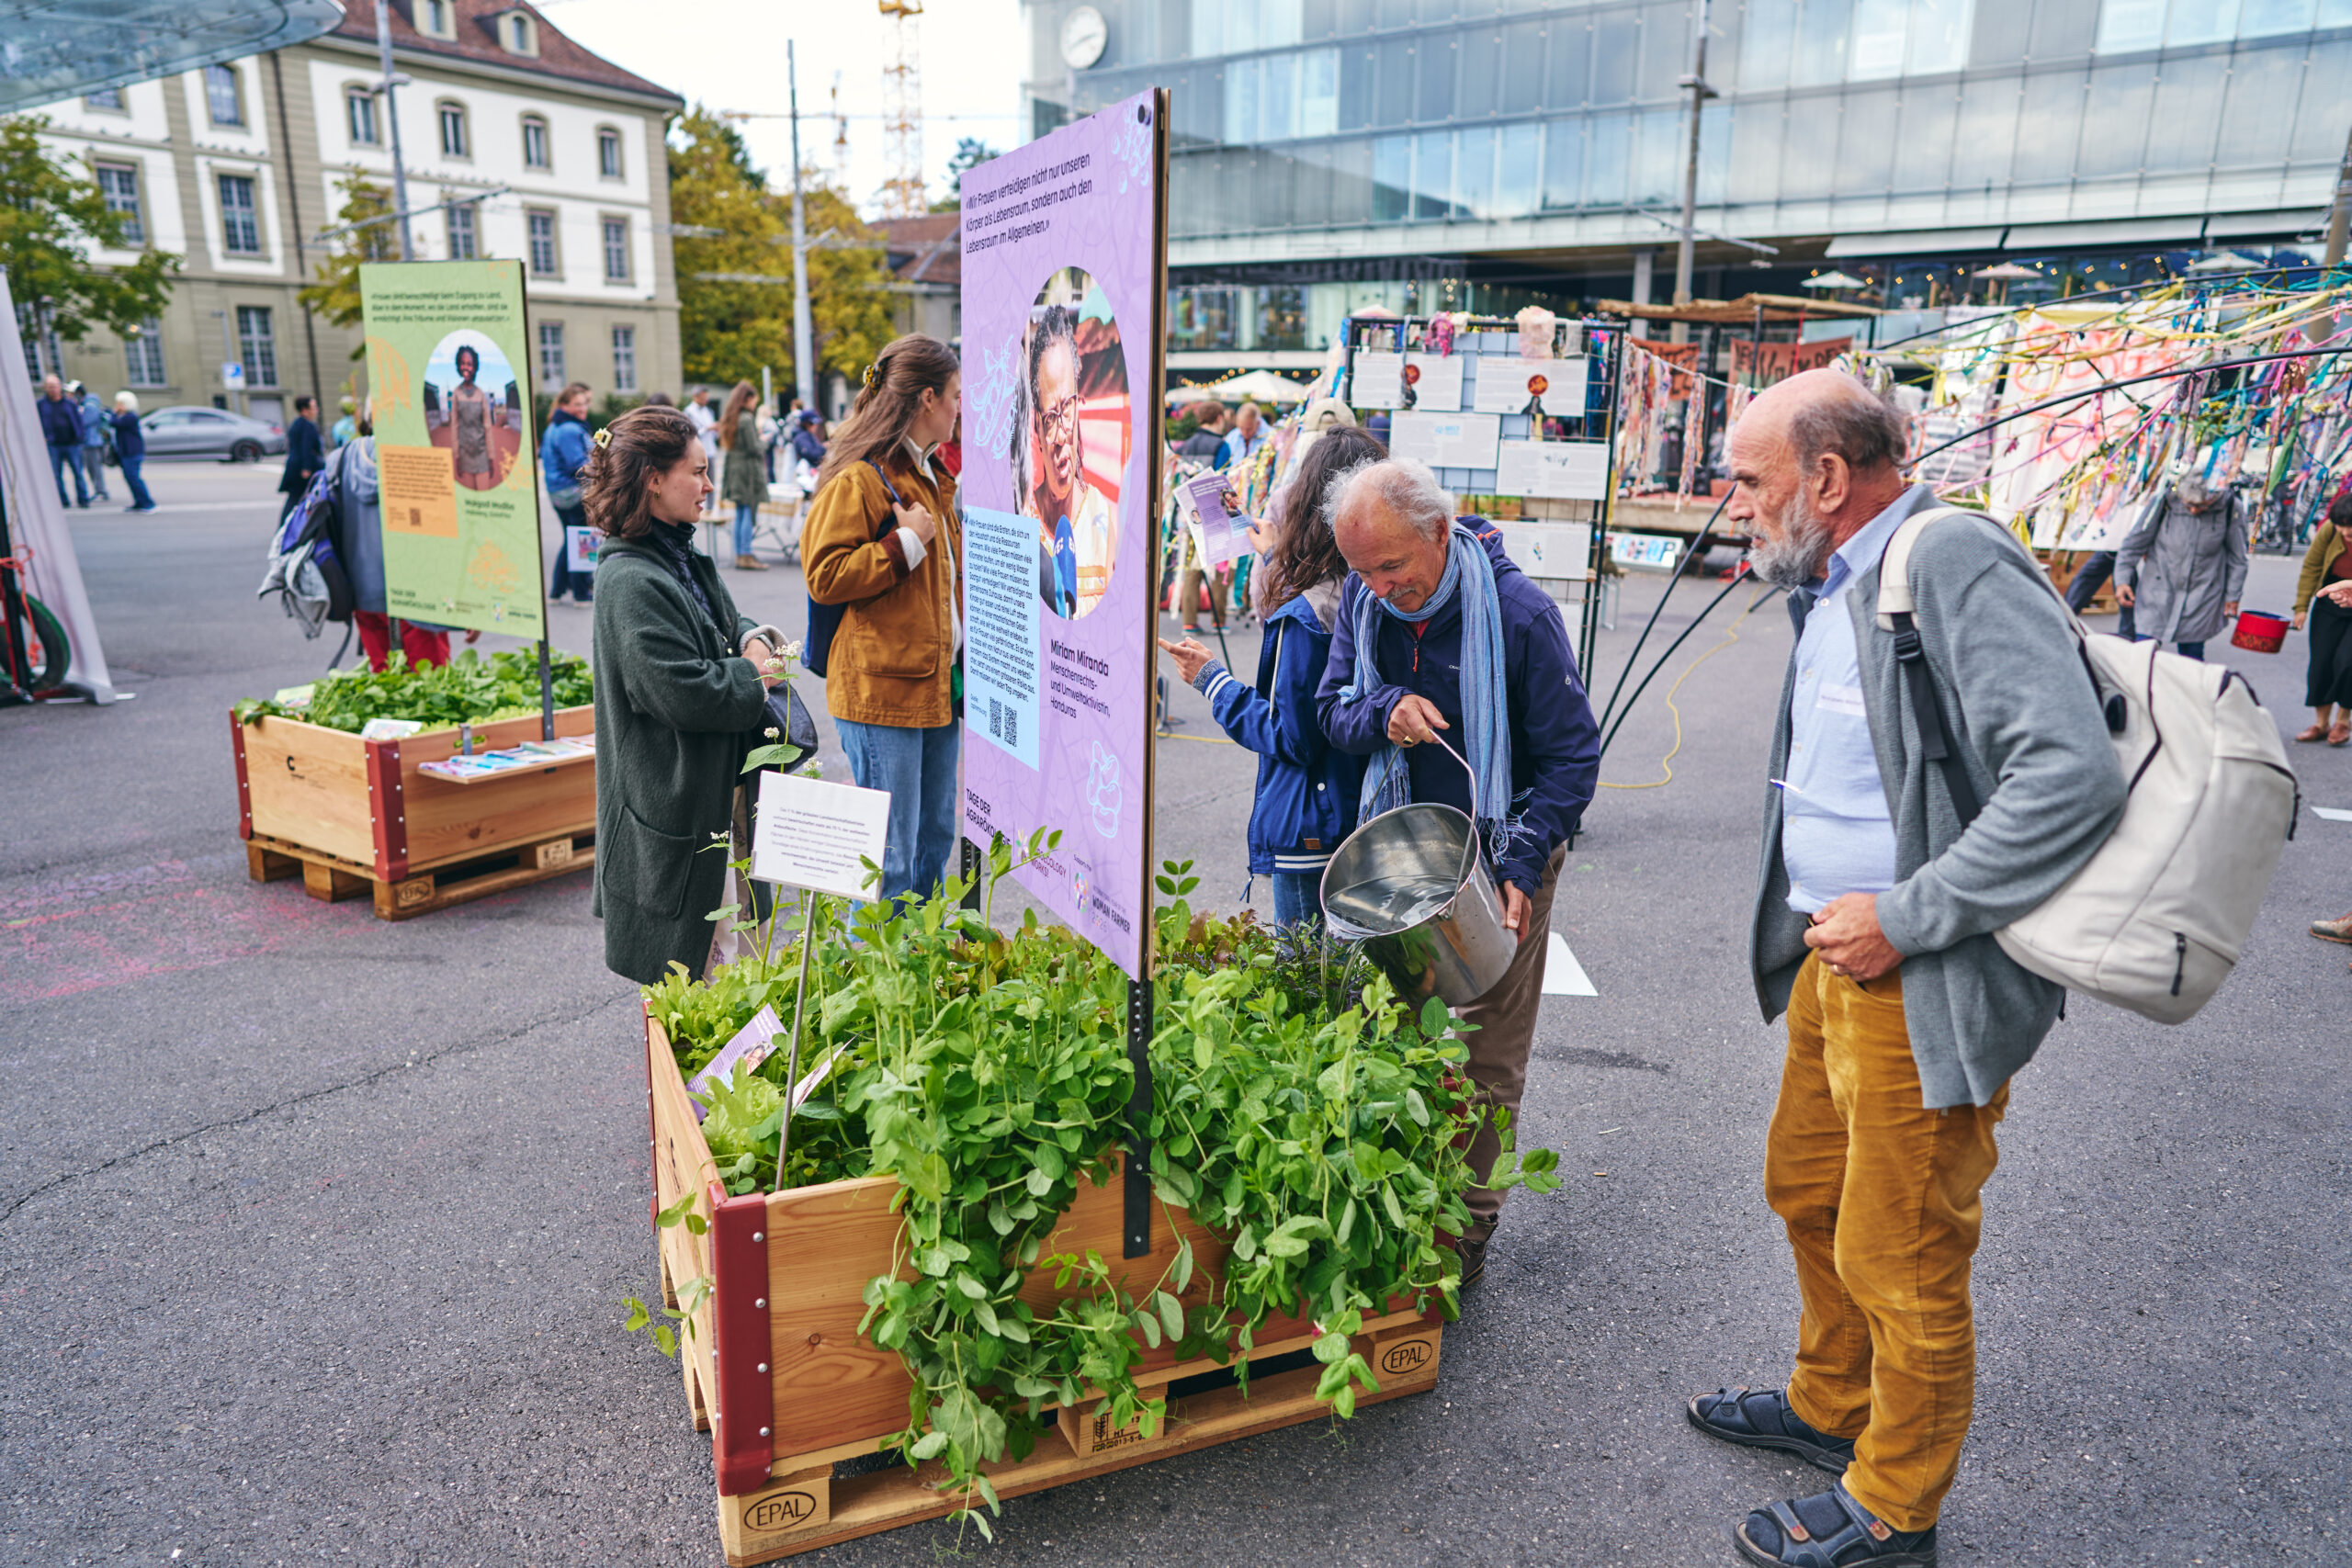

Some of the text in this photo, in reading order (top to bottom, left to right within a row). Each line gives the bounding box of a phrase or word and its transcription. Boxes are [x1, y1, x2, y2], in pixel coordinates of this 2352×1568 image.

[966, 153, 1090, 210] «Wir Frauen verteidigen nicht nur unseren
[966, 179, 1092, 232] Körper als Lebensraum, sondern auch den
[966, 220, 1049, 254] Lebensraum im Allgemeinen.»
[1051, 639, 1108, 676] Miriam Miranda
[1051, 660, 1097, 690] Menschenrechts-
[1051, 680, 1110, 718] und Umweltaktivistin,
[1051, 696, 1076, 718] Honduras
[967, 788, 990, 817] TAGE DER
[1093, 895, 1110, 918] WOMAN
[1111, 909, 1130, 935] FARMER
[1390, 1346, 1425, 1368] EPAL
[757, 1498, 806, 1526] EPAL
